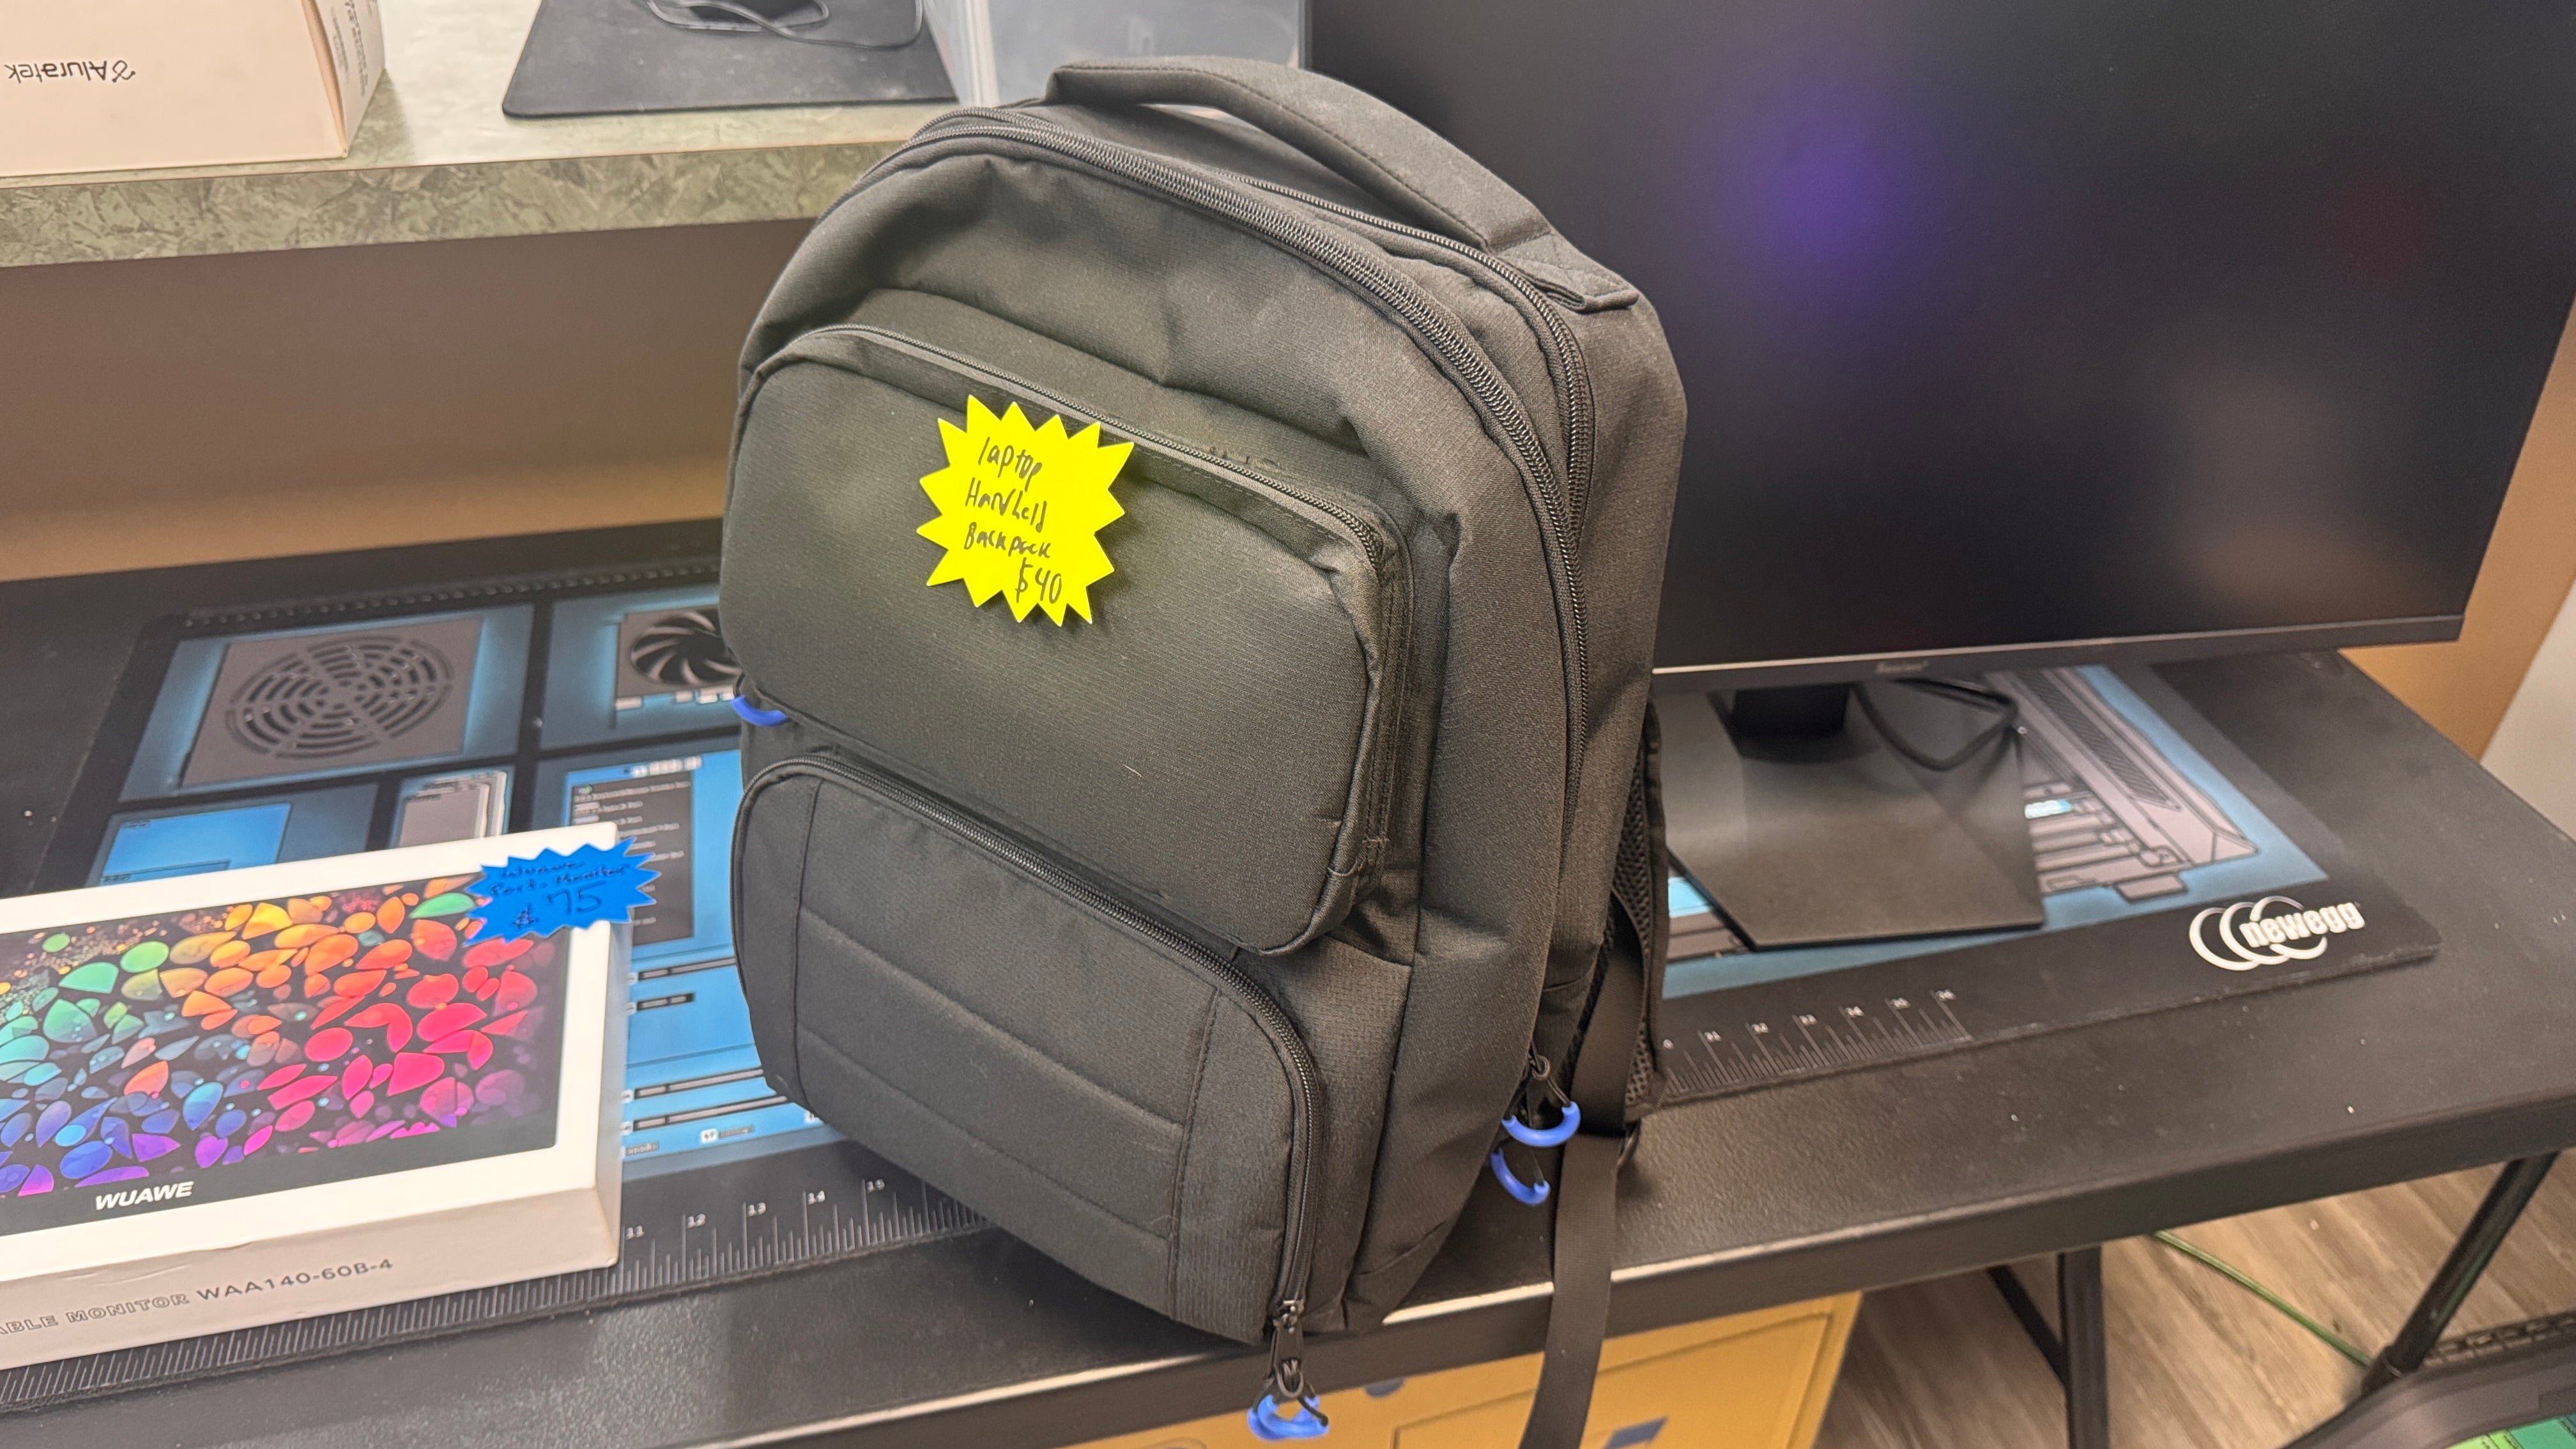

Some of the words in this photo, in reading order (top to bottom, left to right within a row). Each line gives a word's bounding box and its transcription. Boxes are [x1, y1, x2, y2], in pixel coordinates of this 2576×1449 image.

[4, 60, 108, 84] Aluratek
[1015, 556, 1062, 604] $40
[2239, 902, 2365, 948] newegg
[95, 1181, 194, 1211] WUAWE
[807, 1190, 826, 1205] 14
[625, 1225, 644, 1240] 11
[686, 1214, 706, 1229] 12
[66, 1293, 190, 1323] MONITOR
[196, 1259, 394, 1301] WAA140-60B-4
